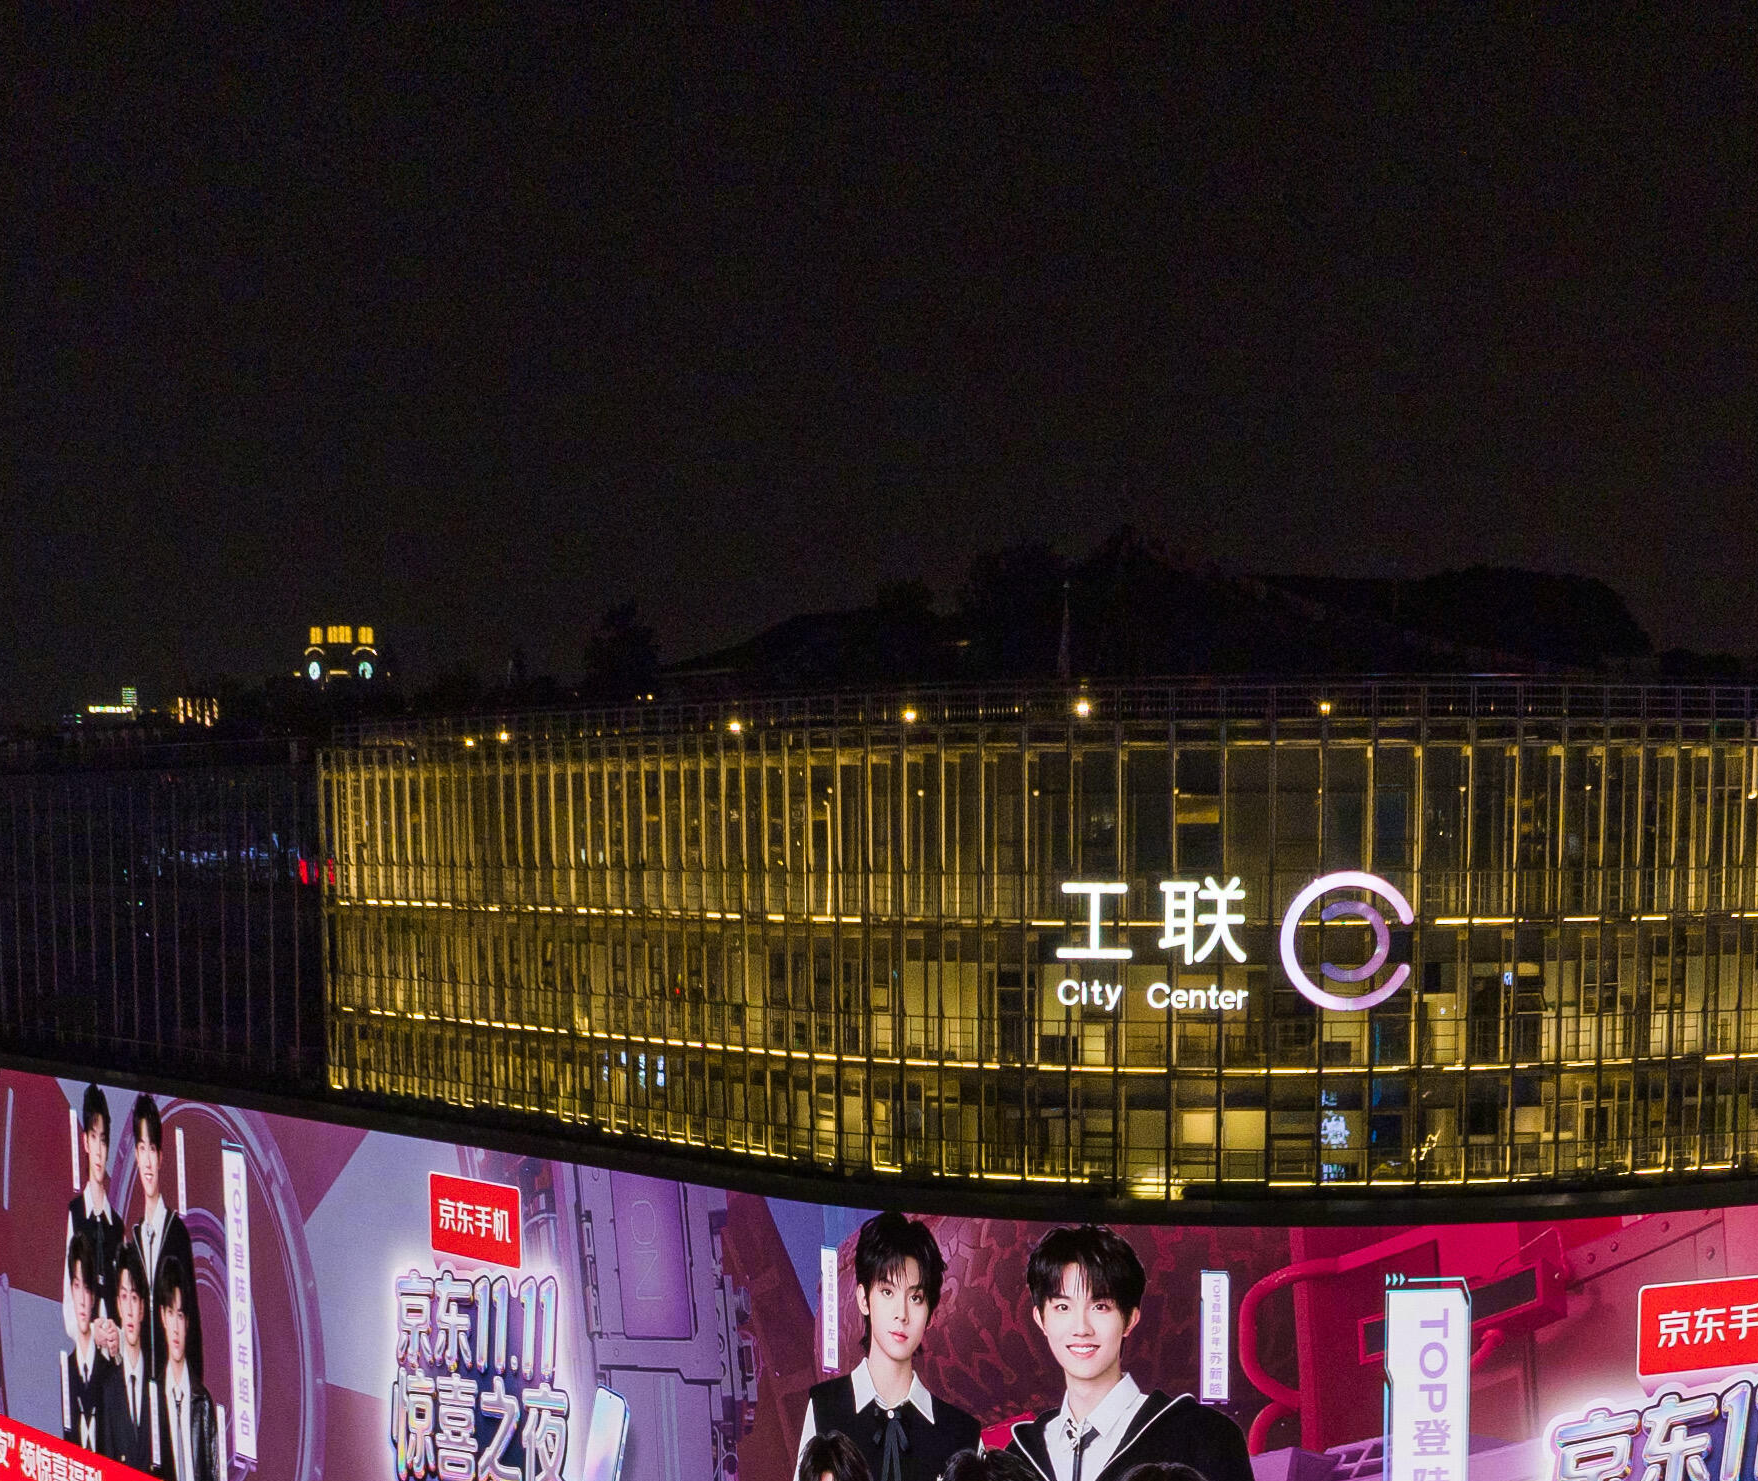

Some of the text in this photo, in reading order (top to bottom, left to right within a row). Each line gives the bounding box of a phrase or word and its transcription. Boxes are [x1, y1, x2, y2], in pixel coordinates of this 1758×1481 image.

[1056, 876, 1248, 965] 工联
[1056, 978, 1249, 1011] City Center
[437, 1198, 512, 1245] 京东手机
[395, 1269, 558, 1382] 京东11.11
